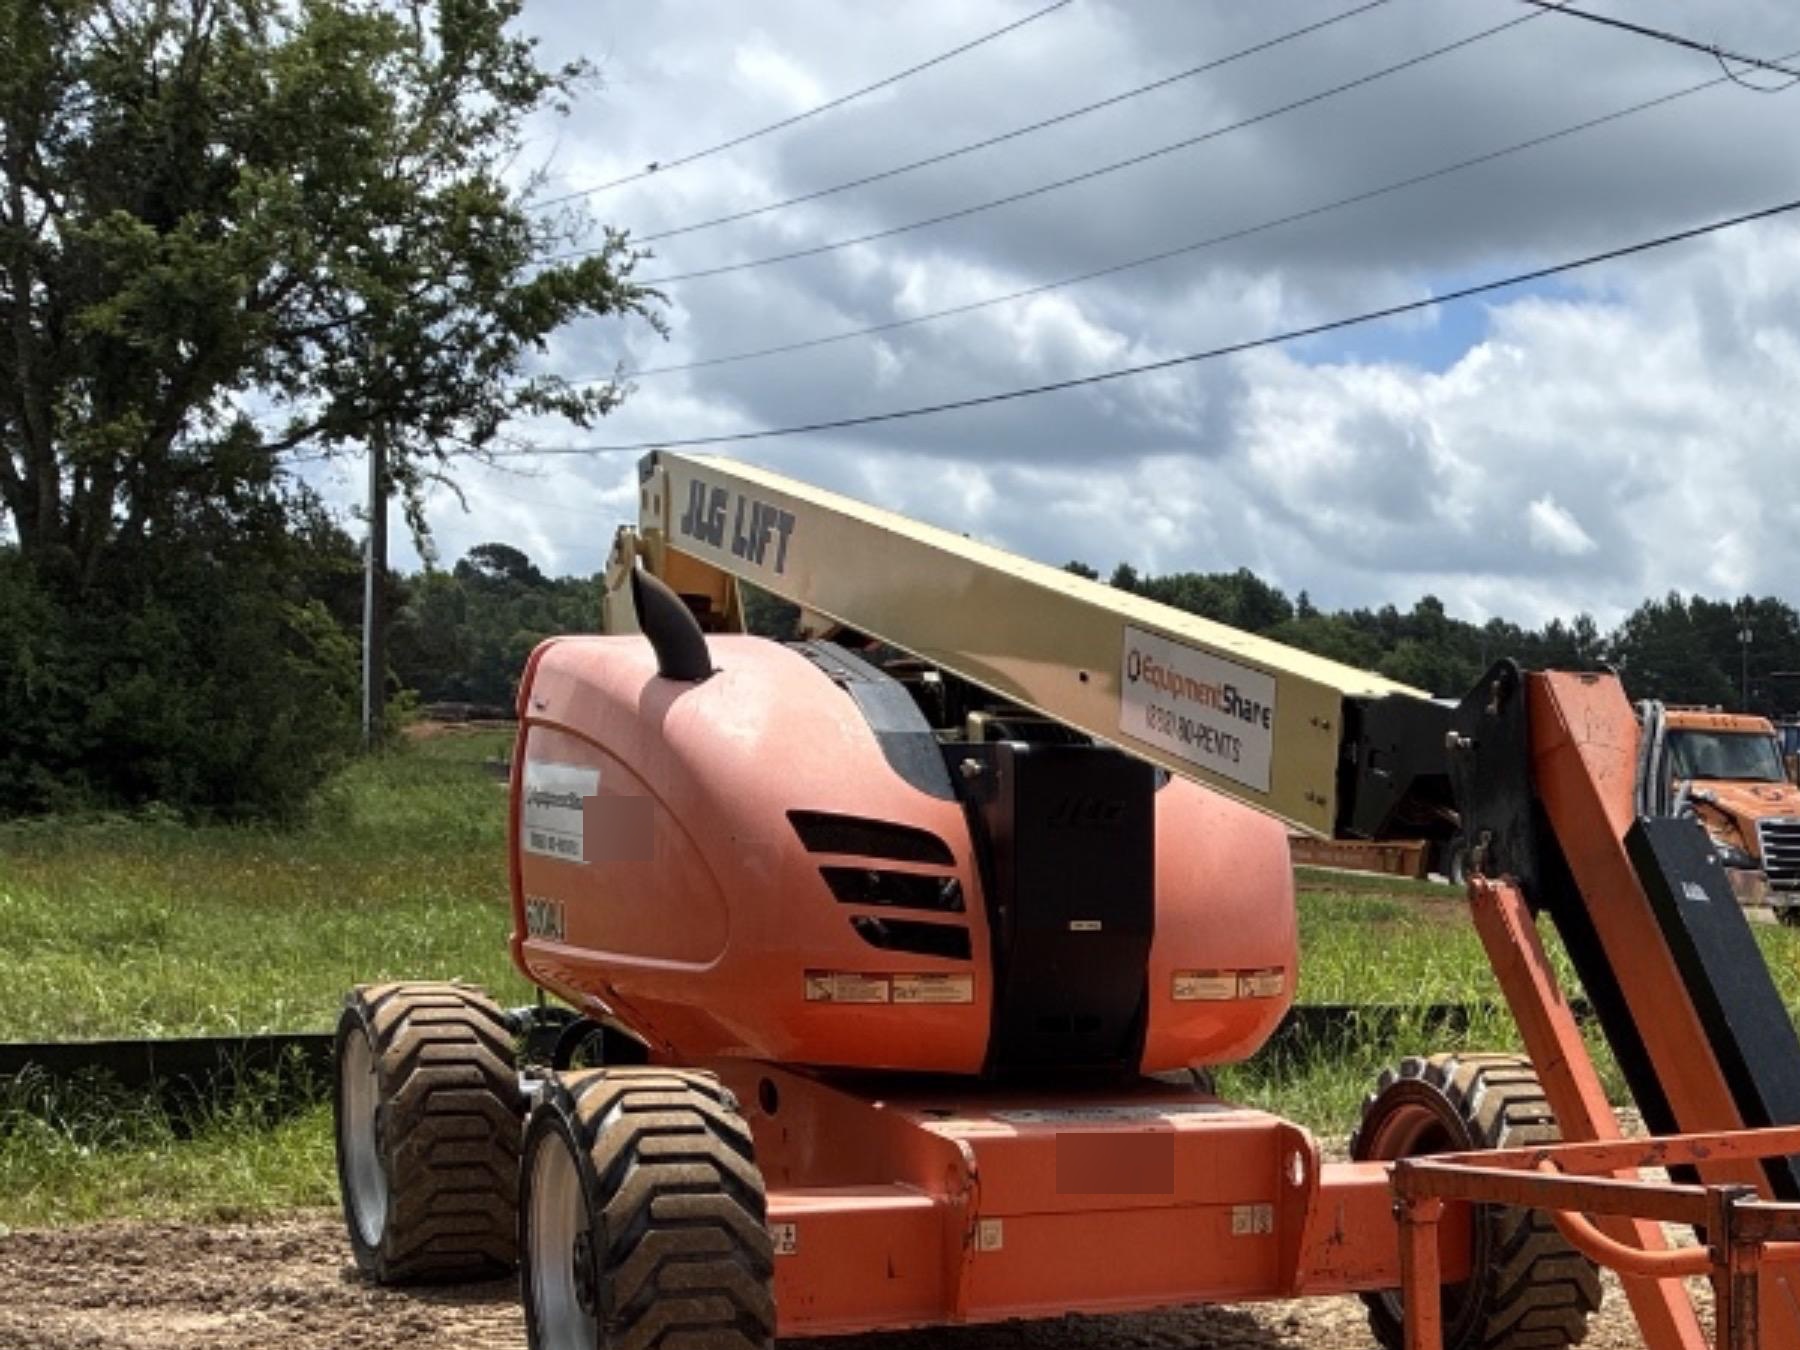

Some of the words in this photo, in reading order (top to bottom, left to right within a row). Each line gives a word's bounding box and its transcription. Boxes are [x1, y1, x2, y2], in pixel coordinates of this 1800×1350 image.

[681, 480, 729, 548] JLG
[732, 495, 796, 573] LIFT
[1143, 655, 1271, 729] EquipmentShare
